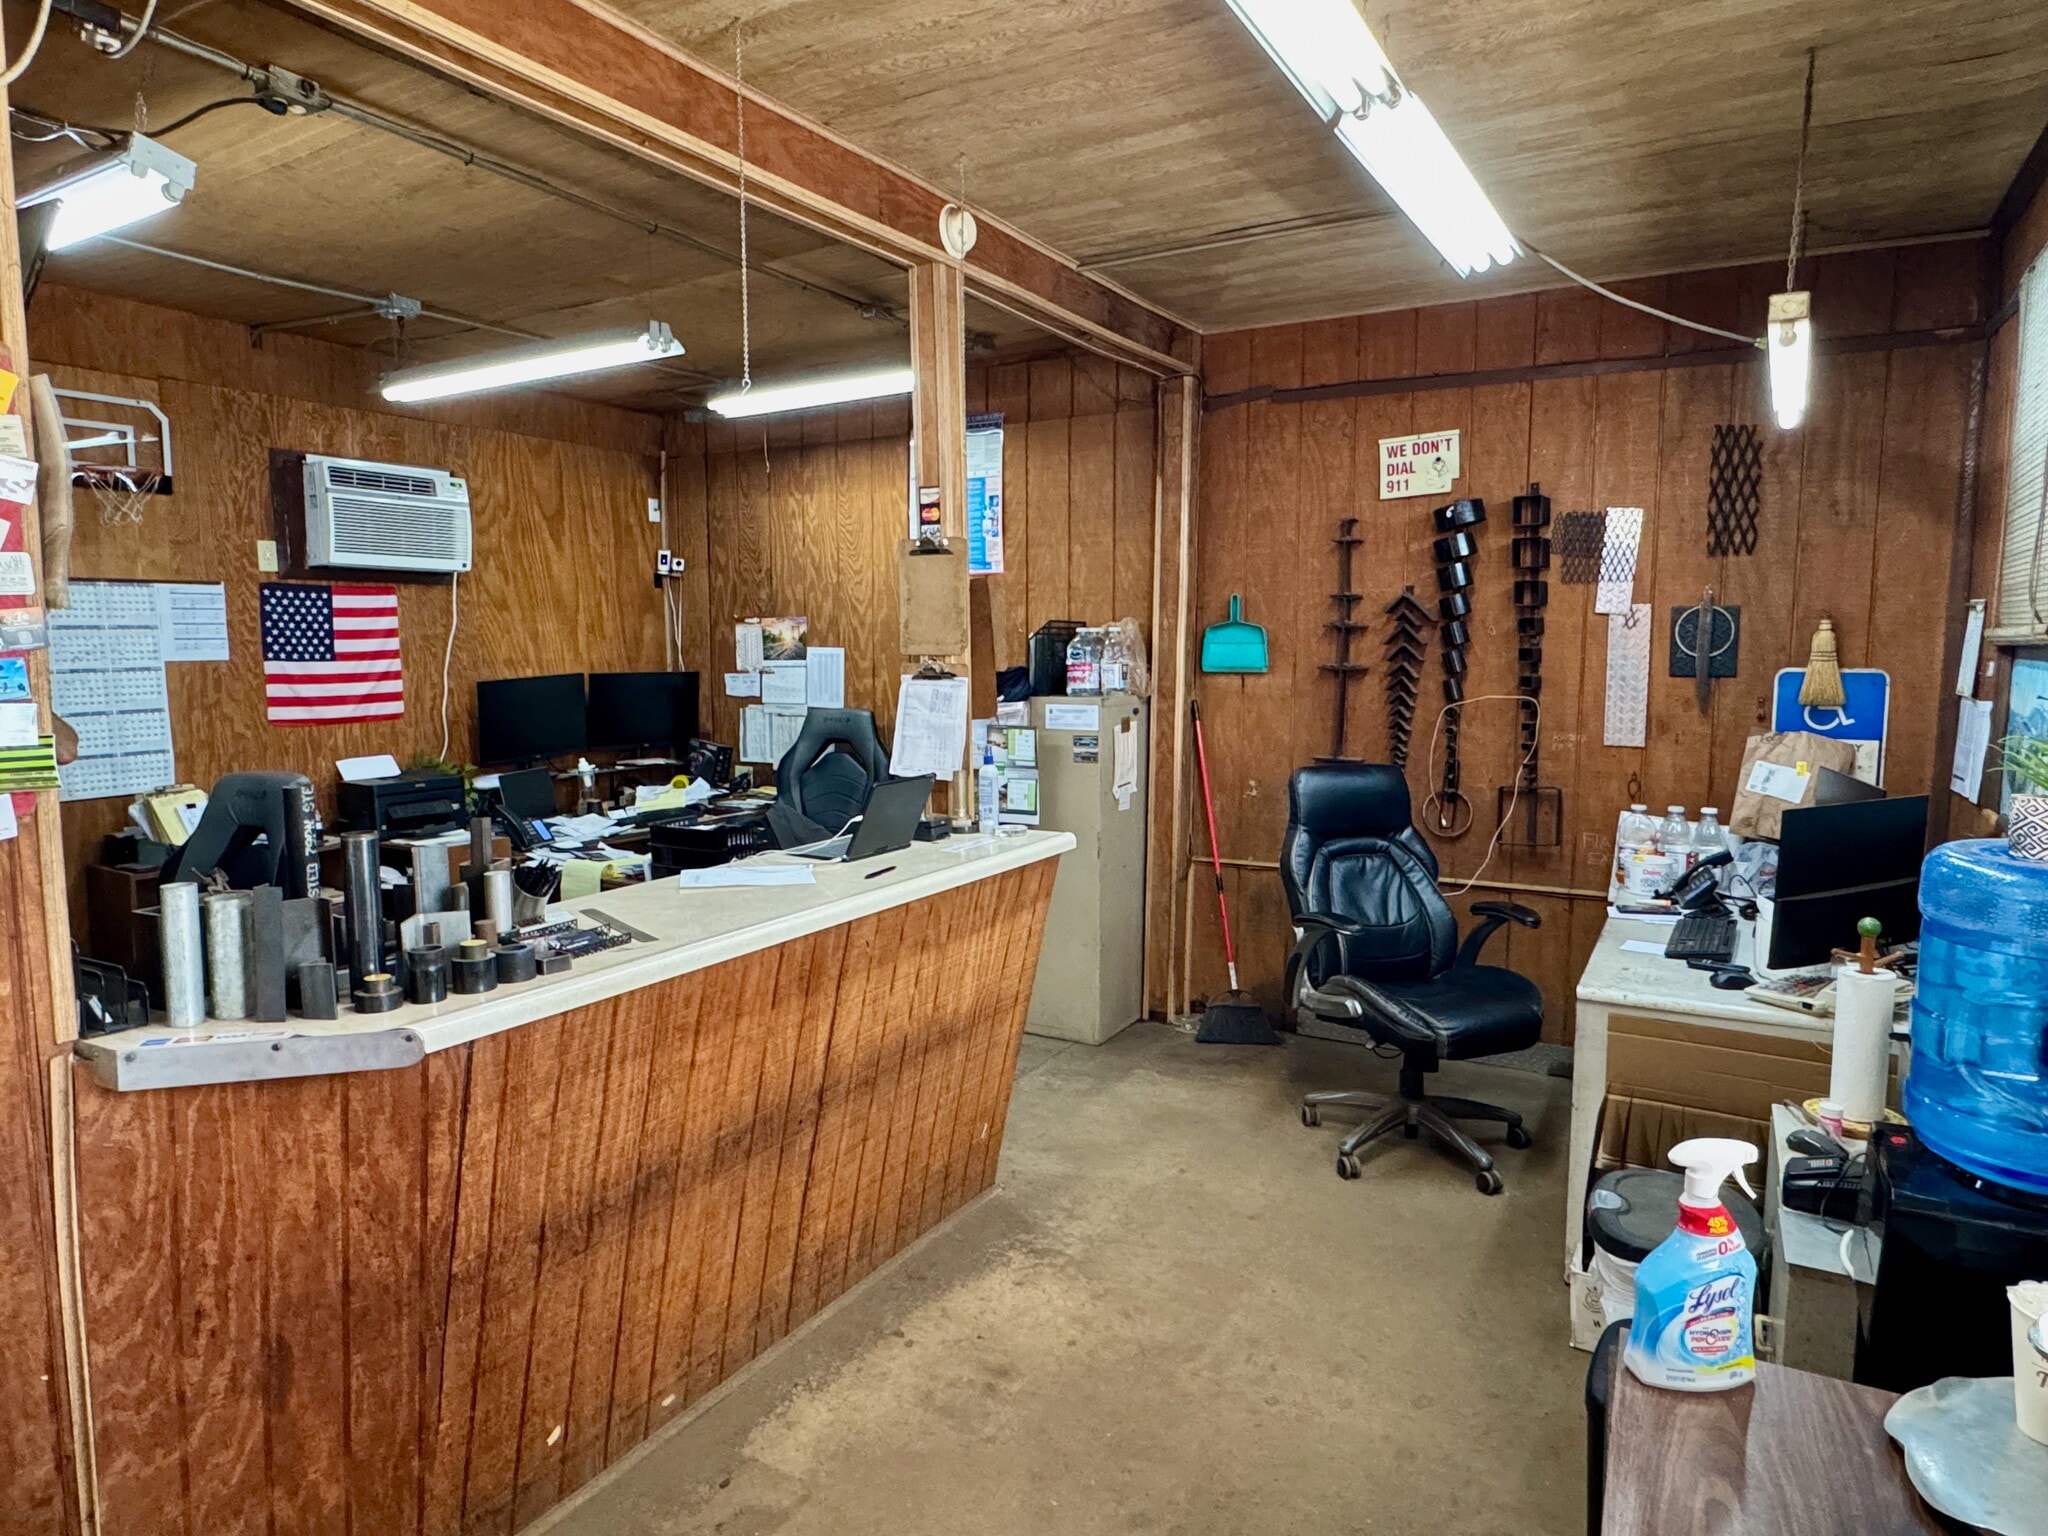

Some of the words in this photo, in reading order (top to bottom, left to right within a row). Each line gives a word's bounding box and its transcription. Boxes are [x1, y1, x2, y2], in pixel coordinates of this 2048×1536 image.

[1386, 444, 1407, 459] WE
[1412, 438, 1453, 456] DON'T
[1387, 461, 1416, 477] DIAL
[1387, 479, 1409, 493] 911
[1688, 1277, 1740, 1314] Lysol
